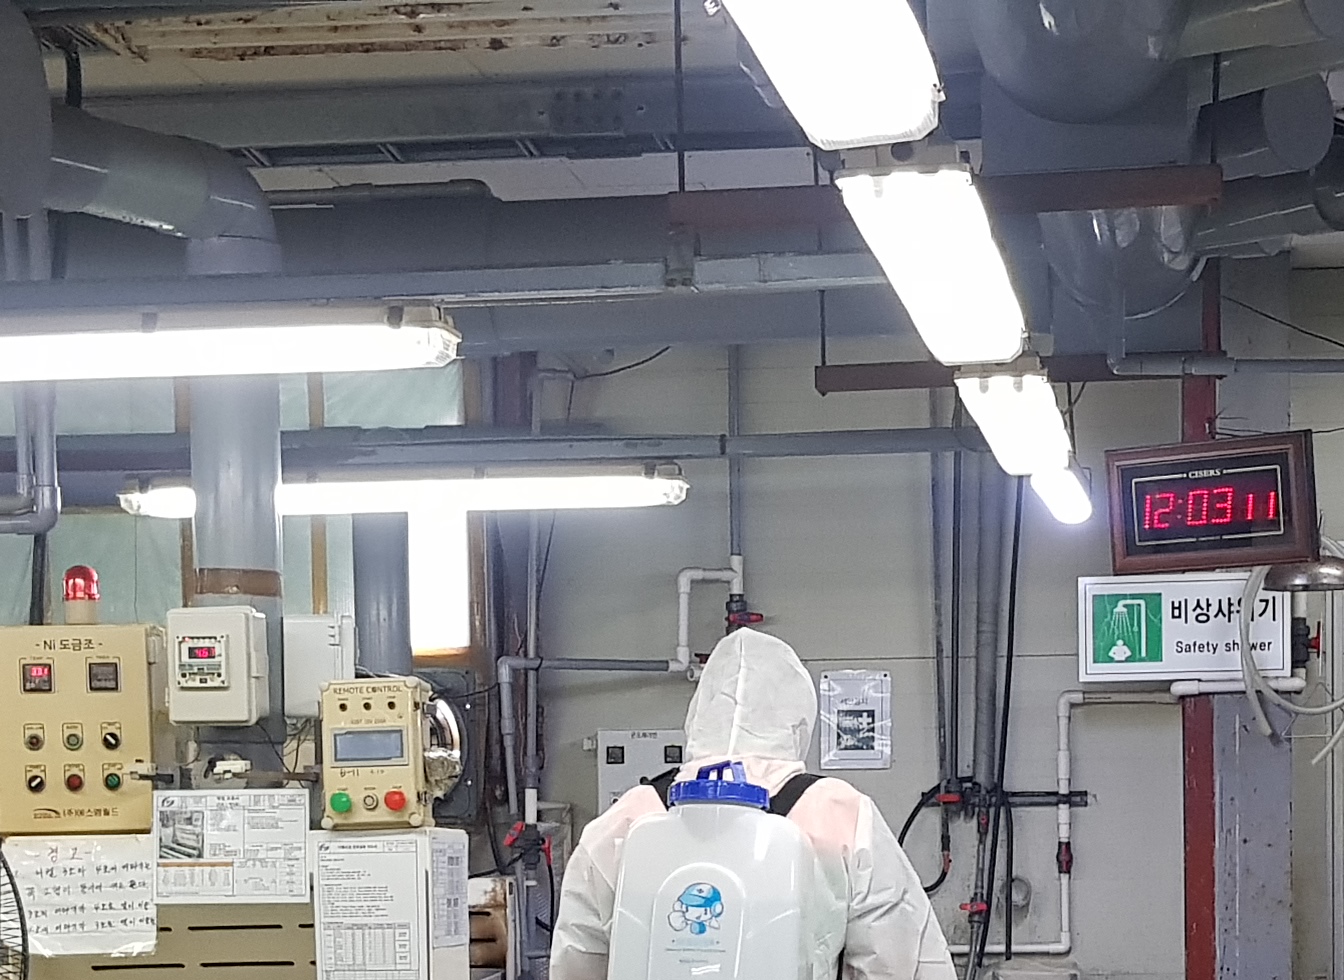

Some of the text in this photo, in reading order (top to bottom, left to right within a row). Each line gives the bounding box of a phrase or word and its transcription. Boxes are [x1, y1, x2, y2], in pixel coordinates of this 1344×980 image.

[1188, 468, 1221, 479] CISERS
[1143, 486, 1277, 530] 12:03 11
[43, 640, 56, 651] Ni
[59, 638, 95, 651] 도금조
[1175, 639, 1272, 655] Safety shwer
[333, 684, 403, 695] REMOTE CONTROL
